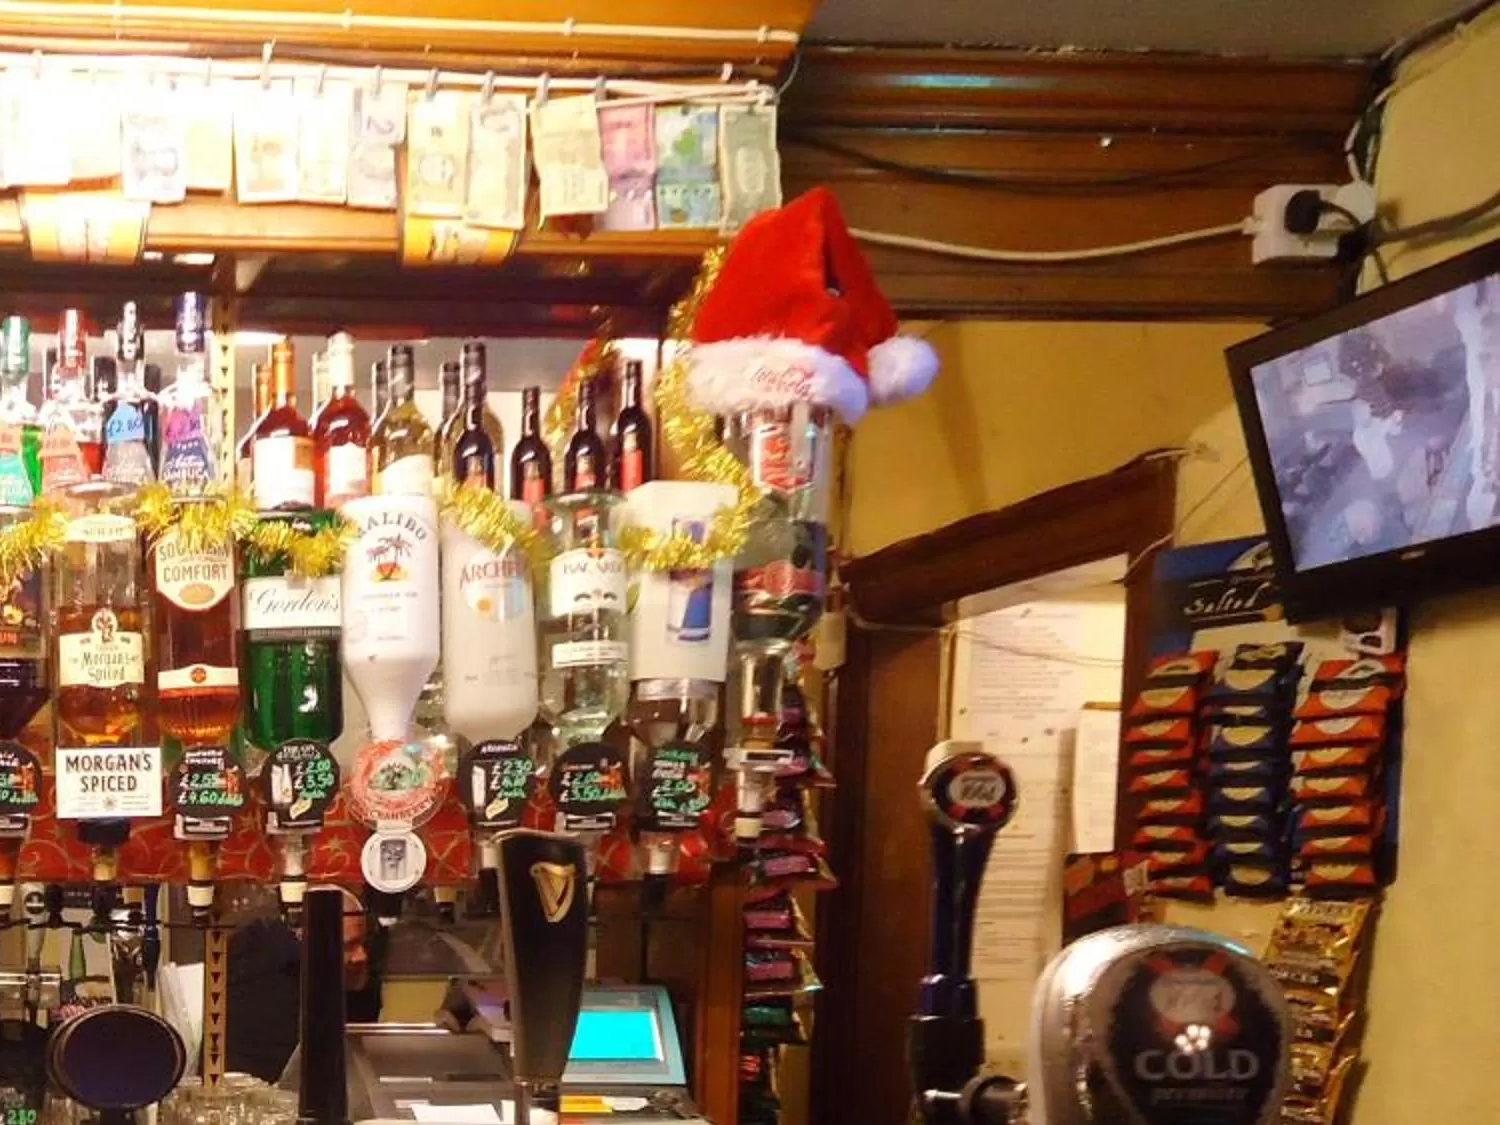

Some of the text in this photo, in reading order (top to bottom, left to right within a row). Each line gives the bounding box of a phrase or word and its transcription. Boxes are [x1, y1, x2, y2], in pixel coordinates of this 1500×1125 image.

[163, 563, 229, 583] COMFORT
[65, 751, 152, 774] MORGAN'S
[80, 776, 138, 793] SPICED
[1133, 1047, 1261, 1082] COLD
